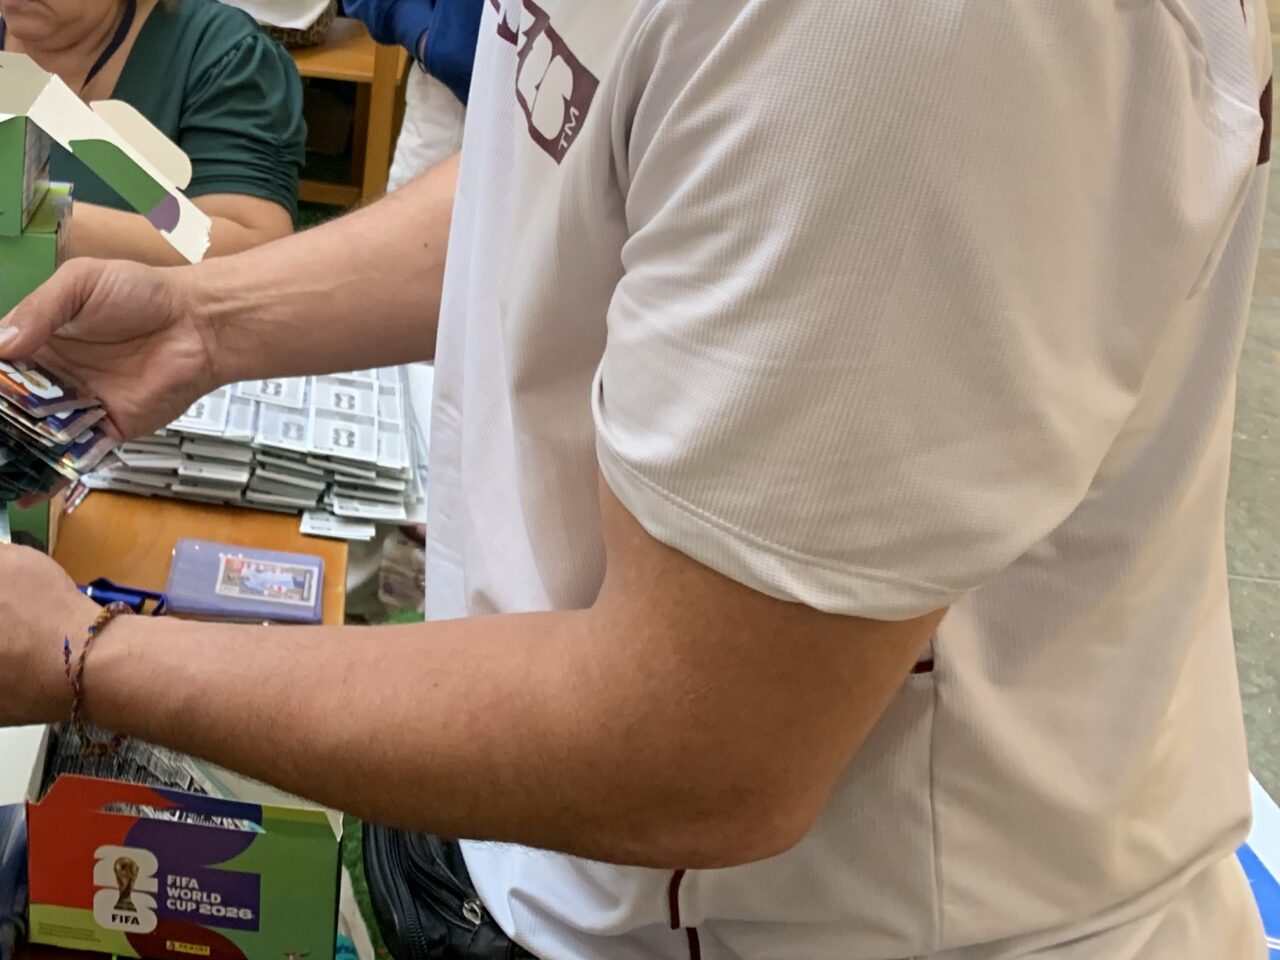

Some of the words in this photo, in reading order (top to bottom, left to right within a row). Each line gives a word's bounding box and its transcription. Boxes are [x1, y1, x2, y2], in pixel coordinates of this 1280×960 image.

[167, 874, 199, 889] FIFA
[166, 887, 221, 904] WORLD
[166, 898, 197, 911] CUP
[199, 903, 253, 920] 2026
[111, 913, 140, 926] FIFA
